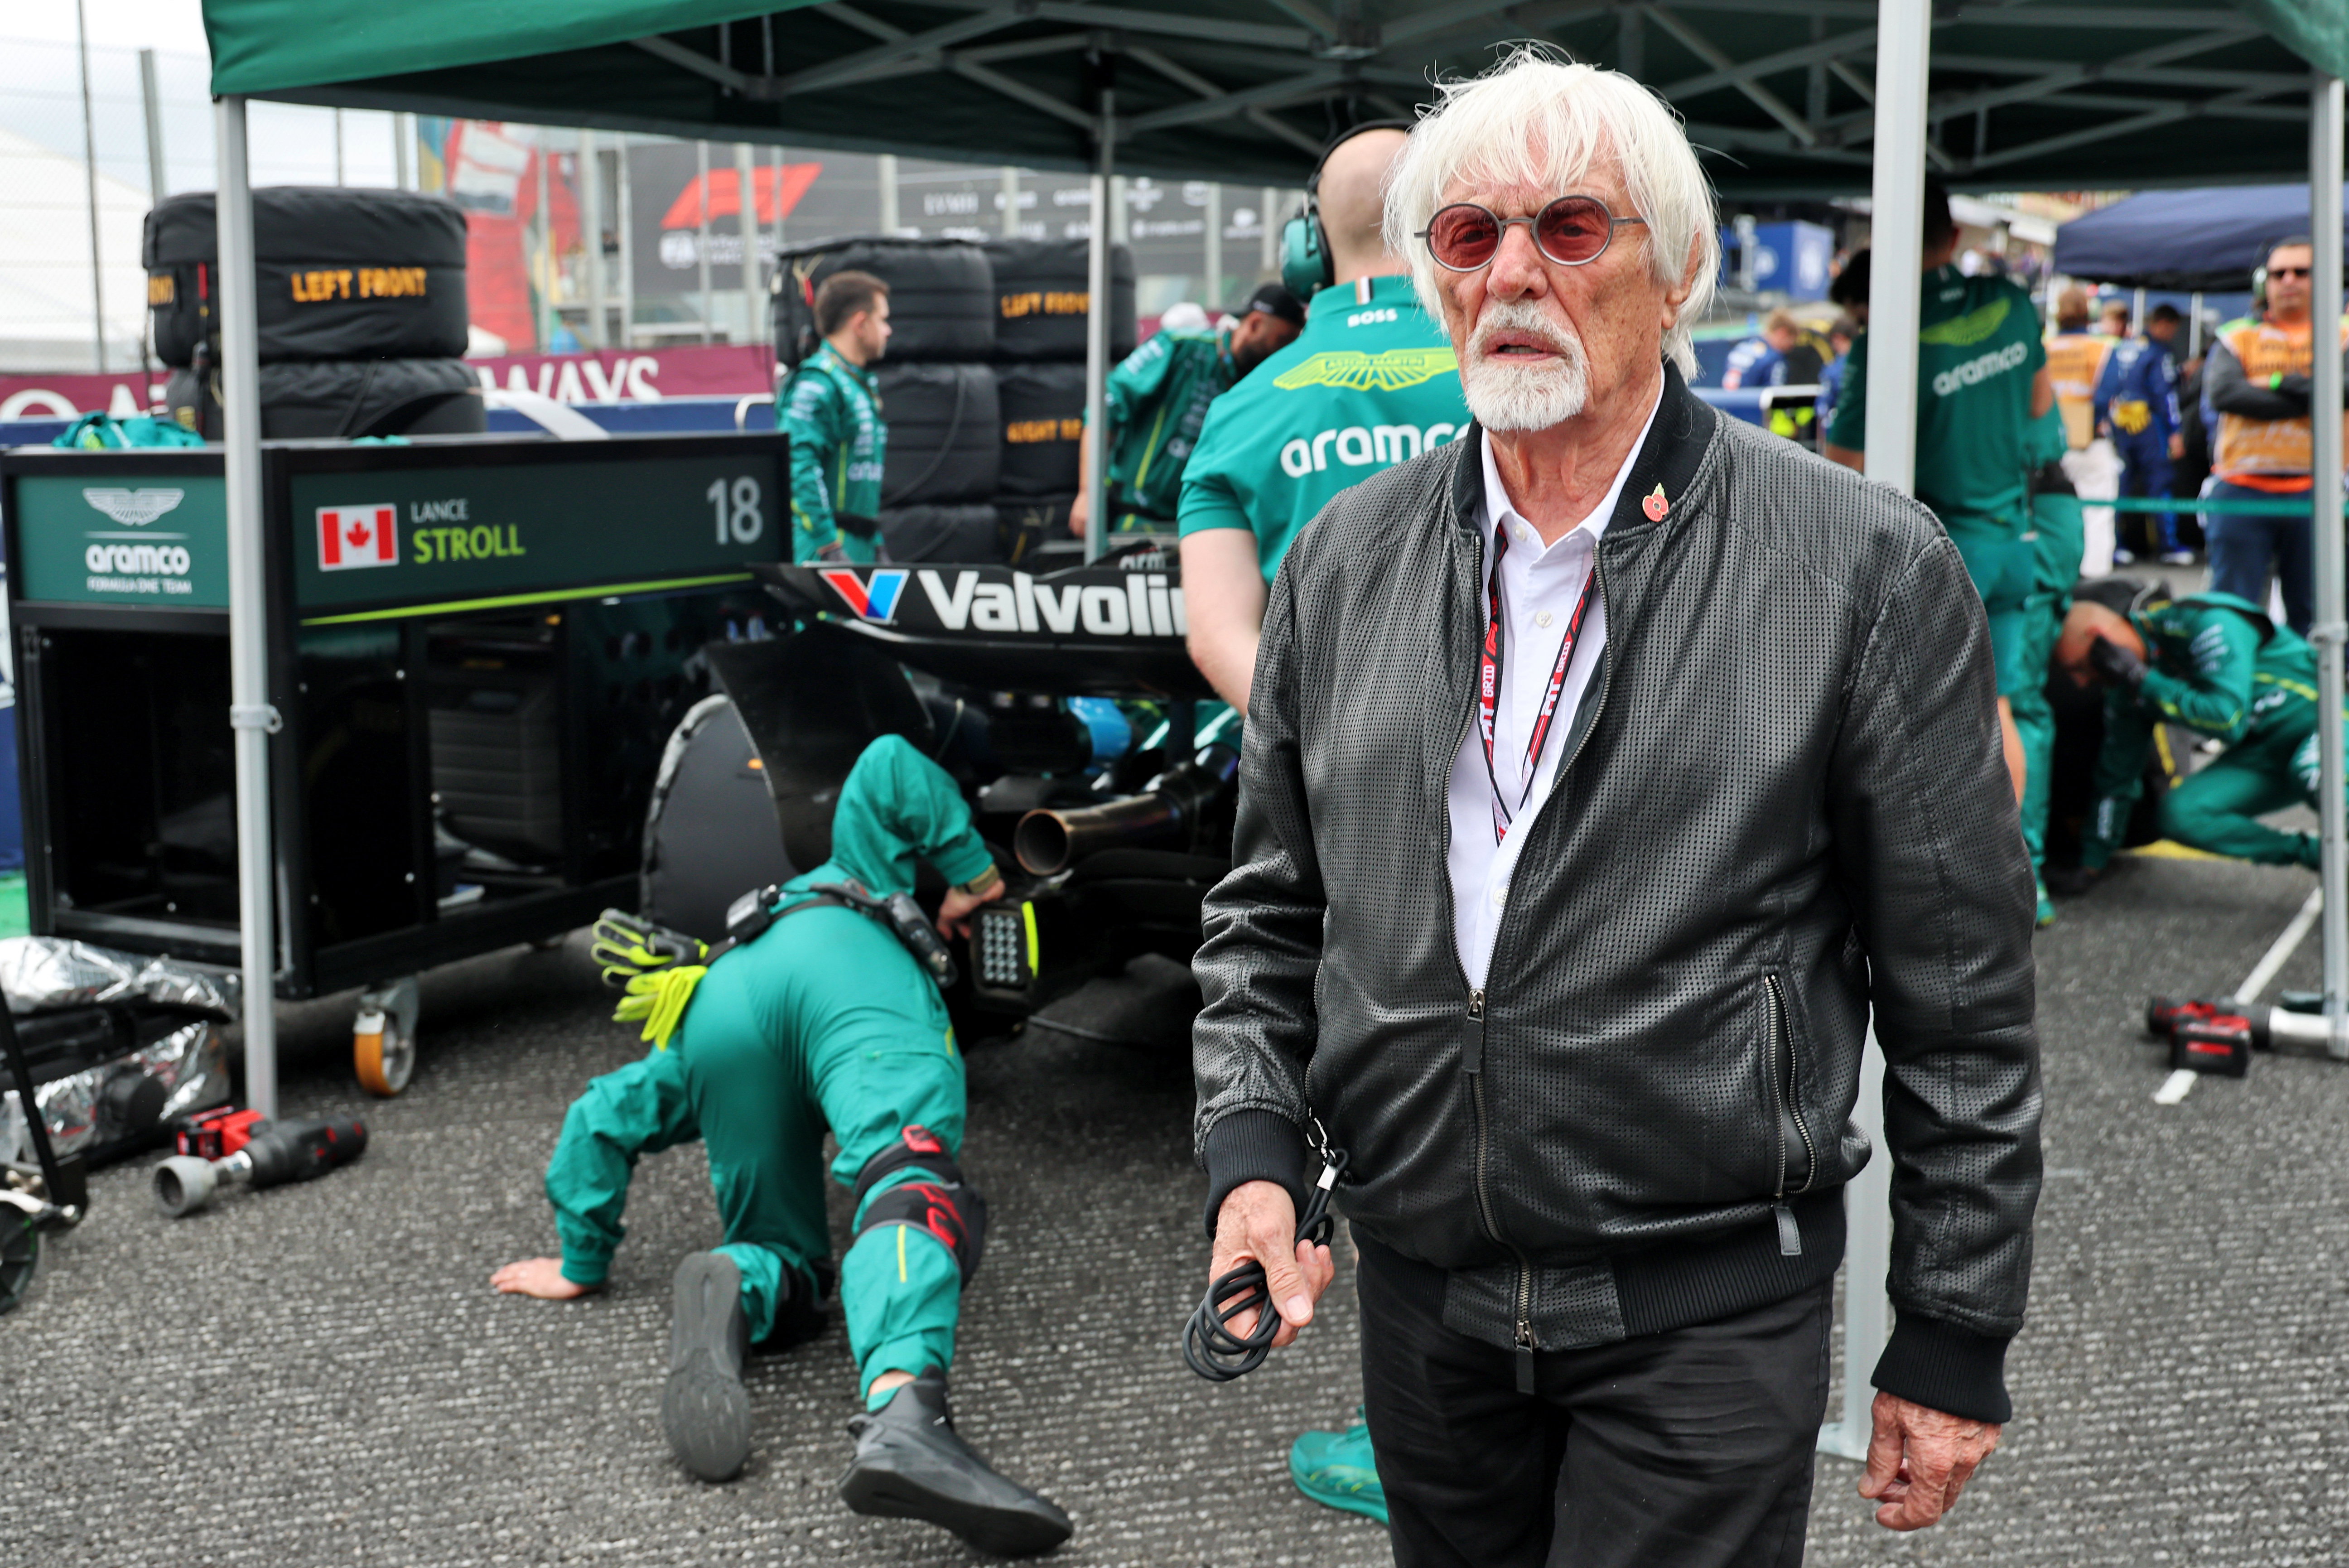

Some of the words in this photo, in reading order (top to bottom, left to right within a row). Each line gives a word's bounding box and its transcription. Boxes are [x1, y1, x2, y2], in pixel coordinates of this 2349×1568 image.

[291, 270, 352, 303] LEFT
[358, 267, 427, 298] FRONT
[1001, 292, 1041, 318] LEFT
[1044, 291, 1090, 314] FRON
[1347, 309, 1398, 327] BOSS
[477, 356, 663, 405] WAYS
[1933, 341, 2028, 397] aramco
[1280, 422, 1471, 478] aramc
[411, 499, 468, 523] LANCE
[707, 476, 763, 545] 18
[86, 544, 190, 575] aramco
[413, 524, 526, 564] STROLL
[162, 578, 193, 594] TEAM
[917, 570, 1186, 636] Valvoli
[1556, 641, 1571, 674] GRID
[1483, 664, 1495, 698] GRID
